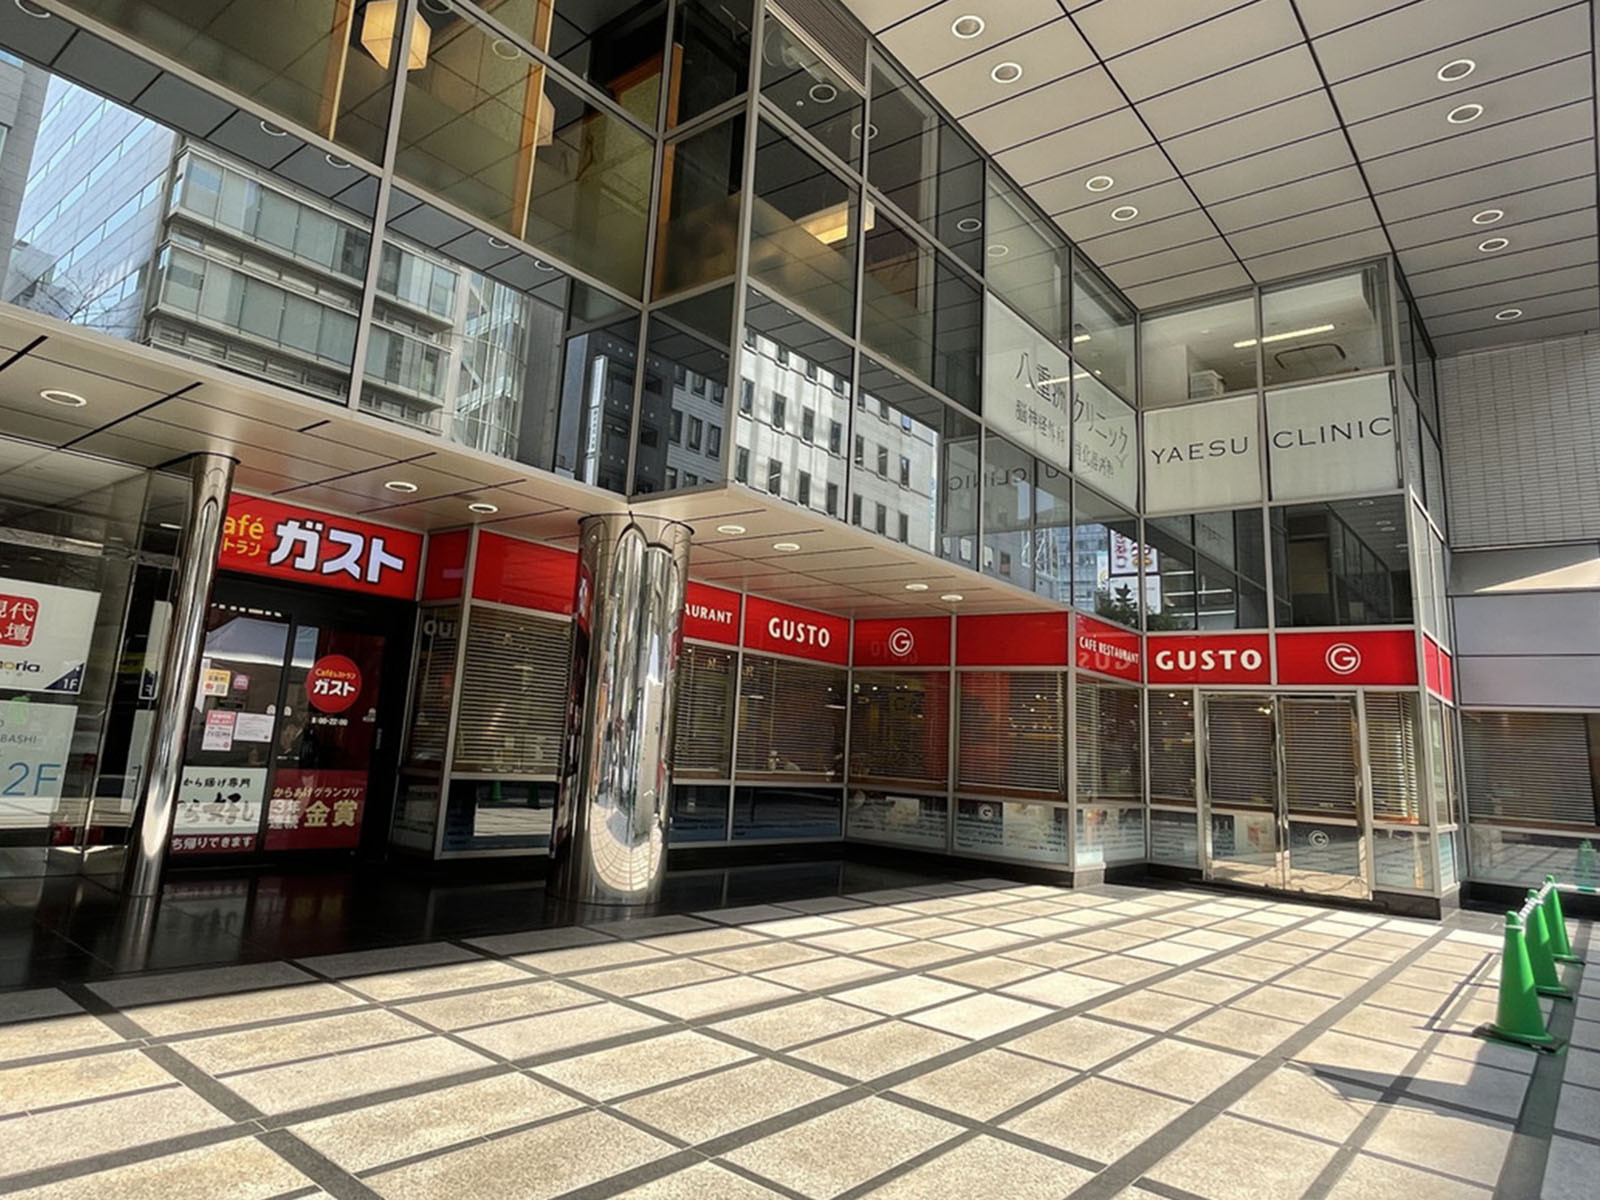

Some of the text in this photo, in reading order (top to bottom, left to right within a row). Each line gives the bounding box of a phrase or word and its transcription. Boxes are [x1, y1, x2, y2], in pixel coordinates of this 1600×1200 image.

[1151, 416, 1393, 465] YAESU CLINIC
[223, 513, 265, 540] afé
[223, 537, 261, 557] トラン
[270, 520, 404, 583] ガスト
[684, 604, 831, 648] AURANT GUSTO
[1097, 642, 1140, 664] RESTAURANT
[1154, 649, 1263, 671] GUSTO
[63, 678, 79, 690] 1F
[313, 679, 356, 697] ガスト
[0, 733, 37, 745] BASHI
[2, 761, 62, 796] 2F
[303, 799, 358, 827] 金賞
[171, 836, 253, 851] ち帰りできます
